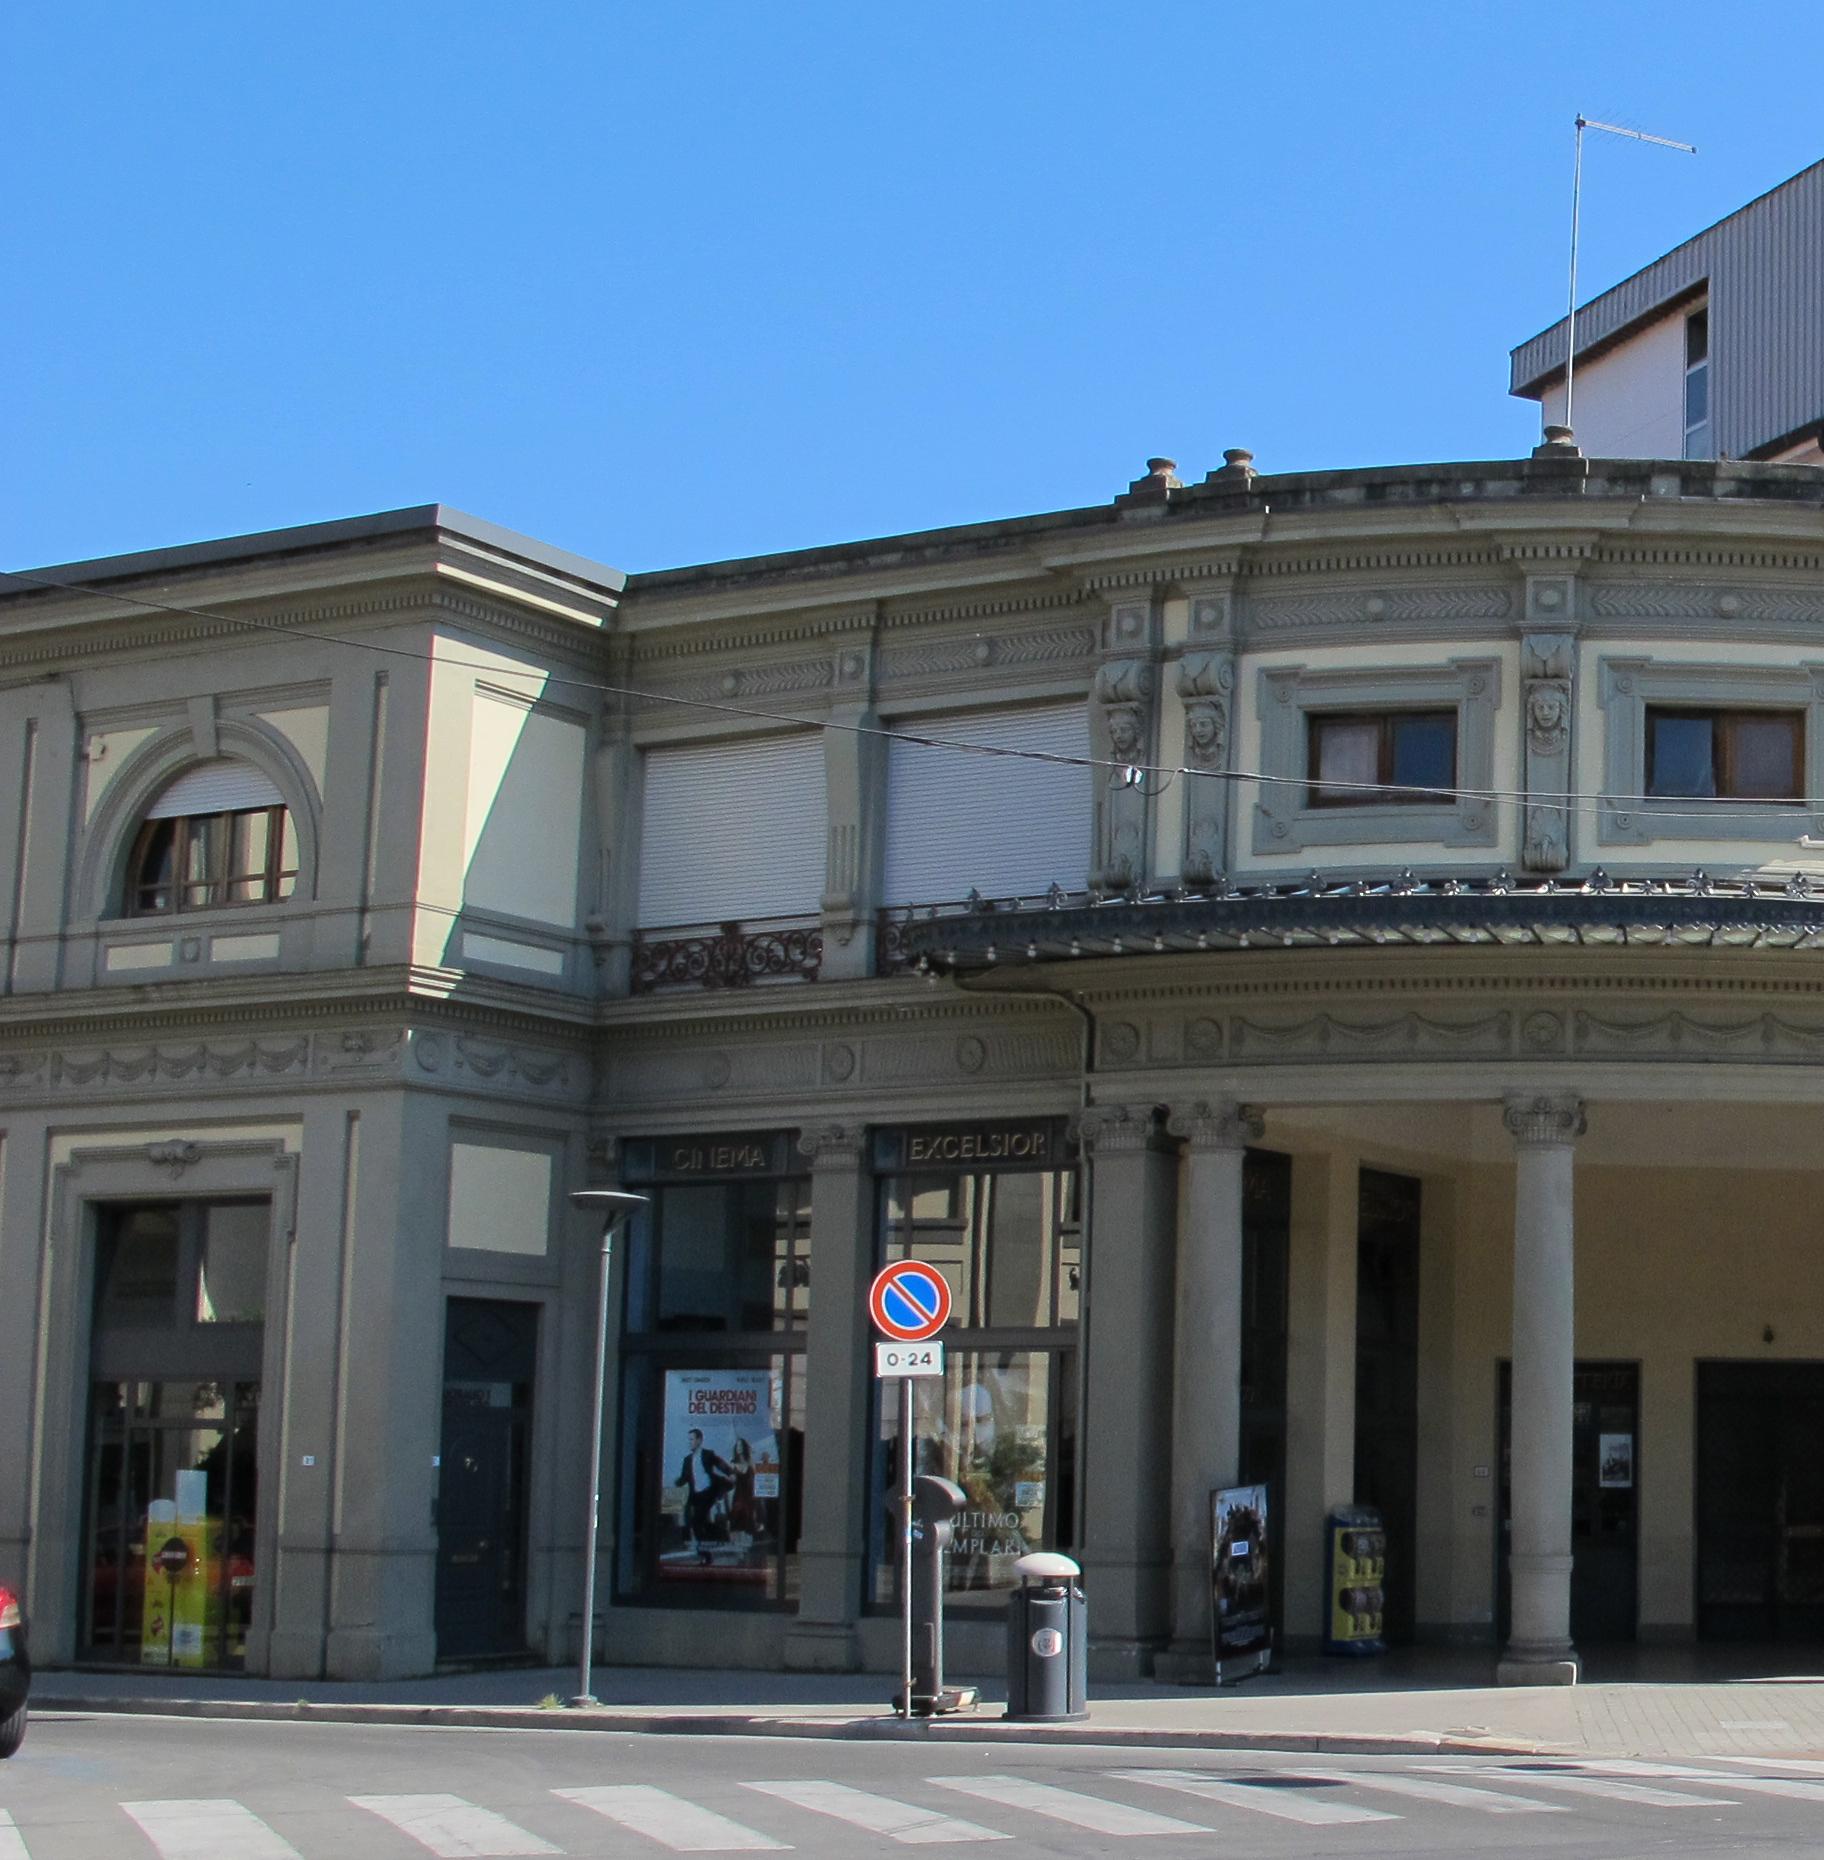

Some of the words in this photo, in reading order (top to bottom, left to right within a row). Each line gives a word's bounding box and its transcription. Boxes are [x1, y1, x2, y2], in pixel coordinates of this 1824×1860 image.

[910, 1133, 1046, 1160] EXCELSIOR
[672, 1144, 765, 1170] CINEMA
[688, 1389, 693, 1402] I
[695, 1389, 757, 1402] GUARDIANI
[688, 1402, 708, 1414] DEL
[710, 1402, 757, 1415] DESTINO
